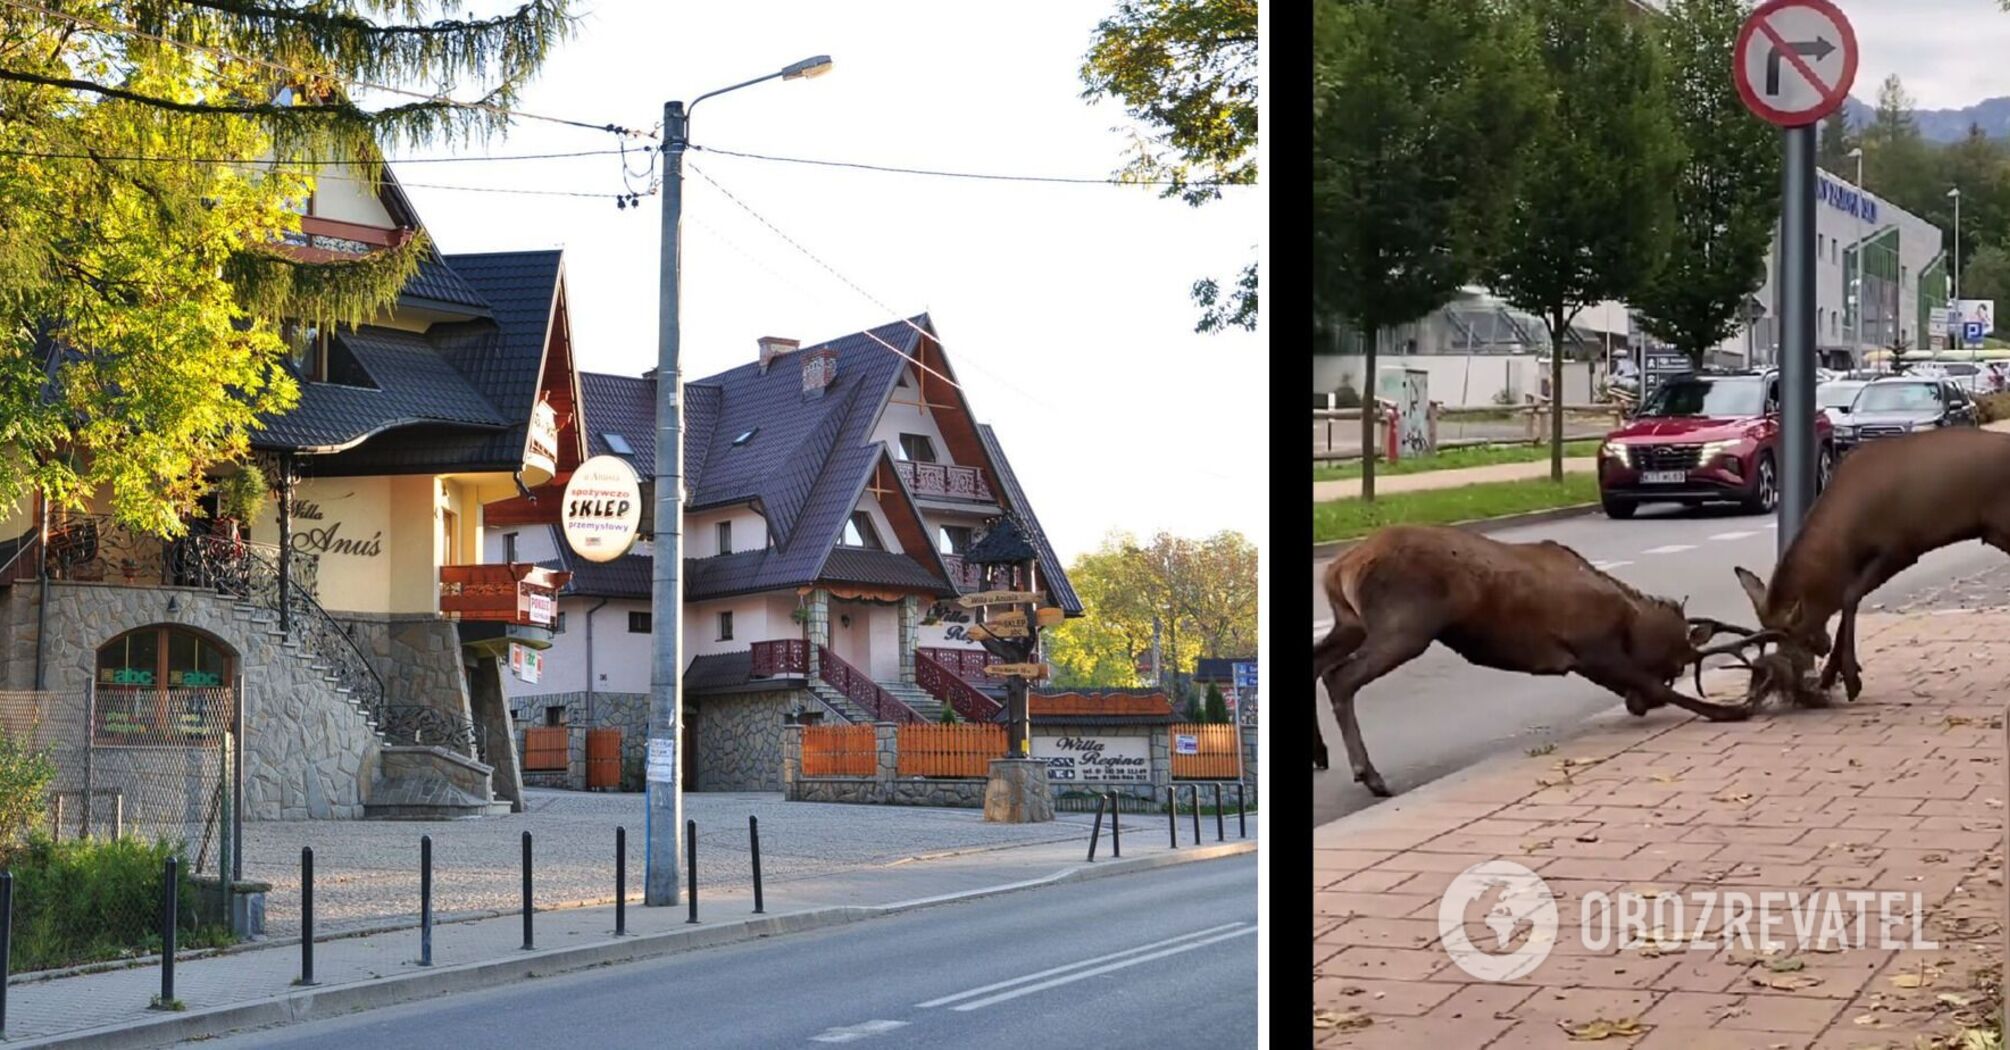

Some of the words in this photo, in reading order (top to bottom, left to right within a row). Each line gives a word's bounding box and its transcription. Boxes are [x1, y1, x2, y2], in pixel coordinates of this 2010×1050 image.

[571, 488, 630, 498] spożywczo
[569, 500, 630, 517] SKLEP
[568, 522, 629, 532] przemysłowy
[291, 521, 381, 557] Anuś
[114, 667, 153, 685] abc
[1056, 736, 1105, 751] Willa
[1079, 751, 1145, 768] Regina
